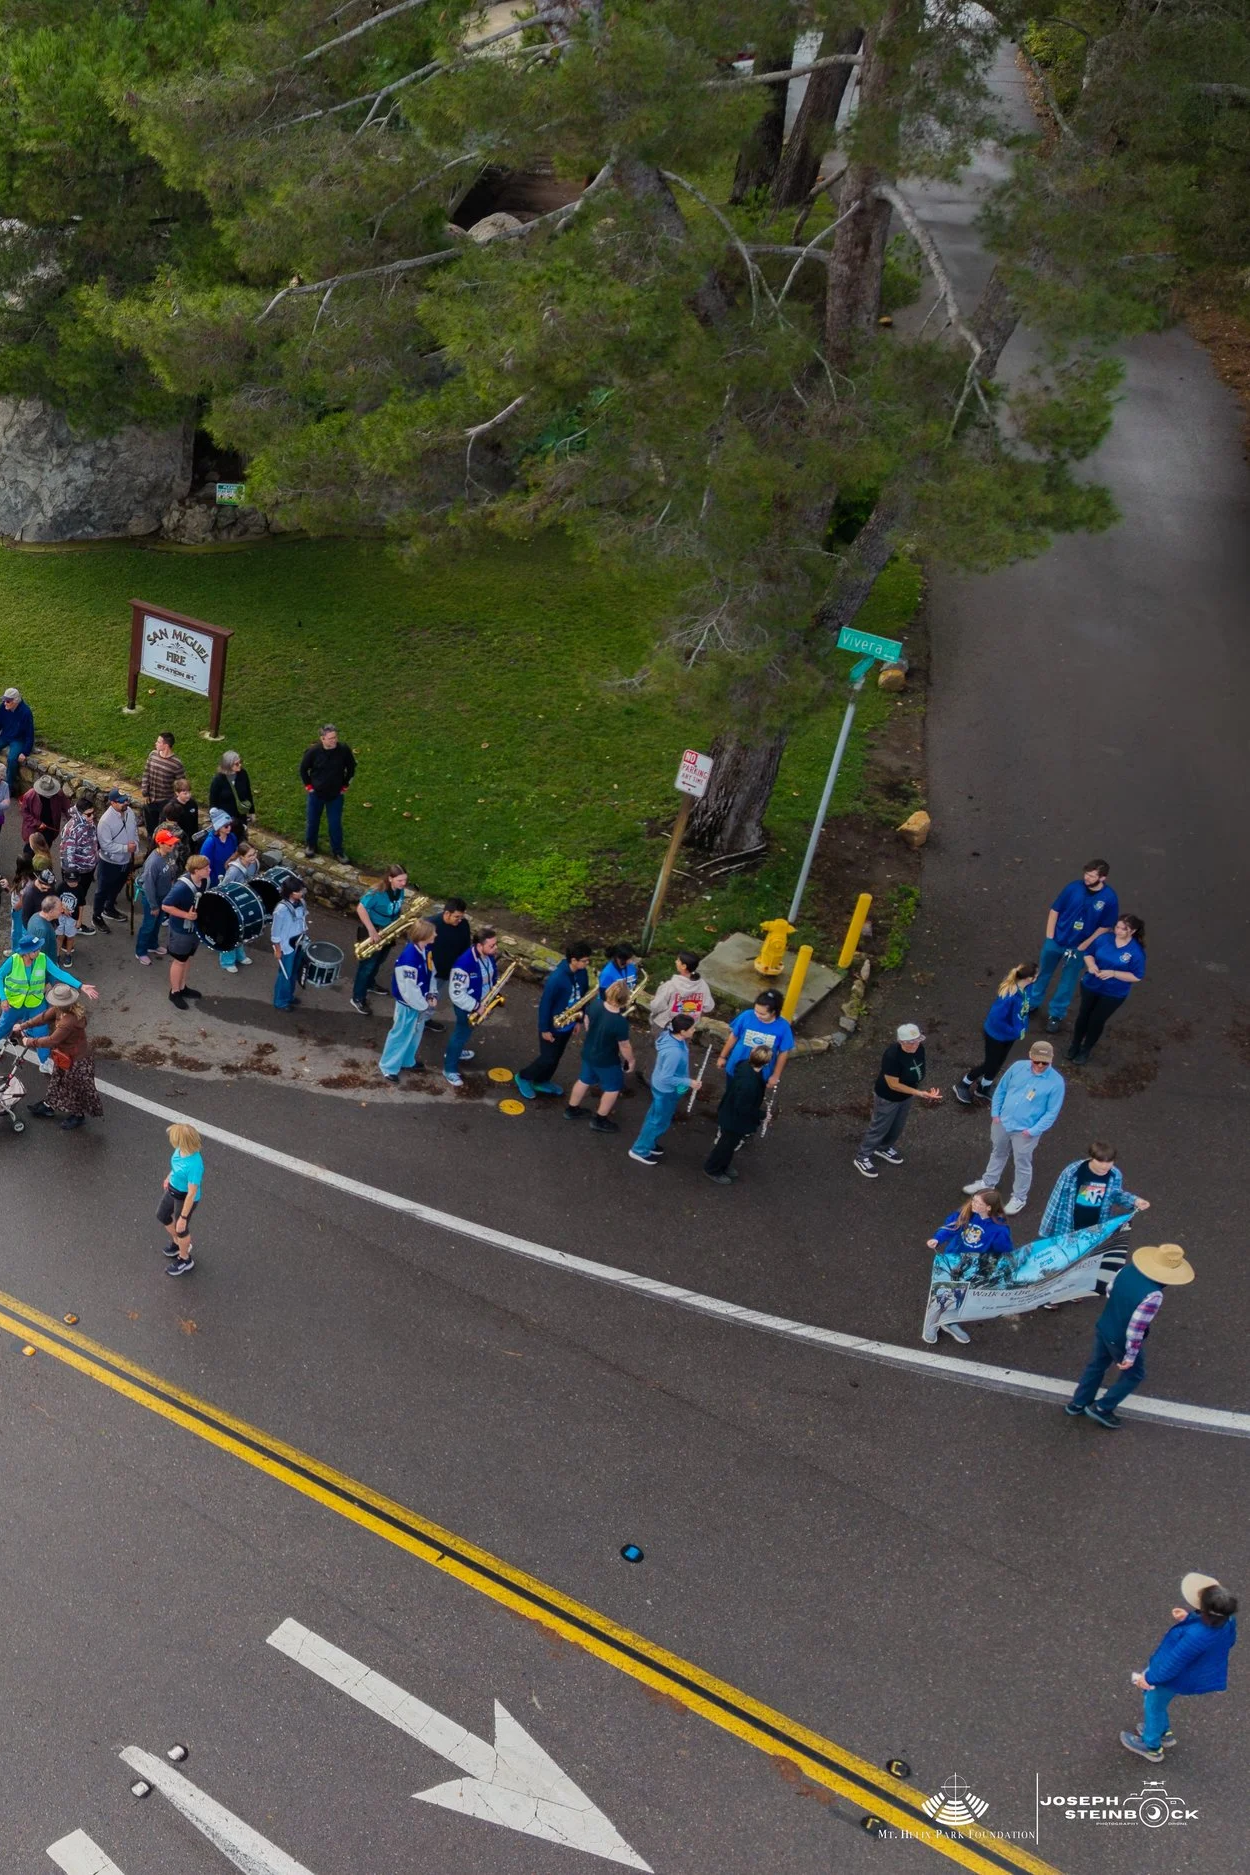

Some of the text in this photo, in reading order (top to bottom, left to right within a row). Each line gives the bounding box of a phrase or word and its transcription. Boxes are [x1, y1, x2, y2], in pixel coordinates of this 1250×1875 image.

[146, 628, 209, 664] SAN MIGUEL
[843, 632, 883, 655] Vivera
[166, 651, 186, 667] FIRE
[157, 664, 184, 678] STATION
[685, 751, 697, 763] NO
[682, 763, 709, 780] PARKING
